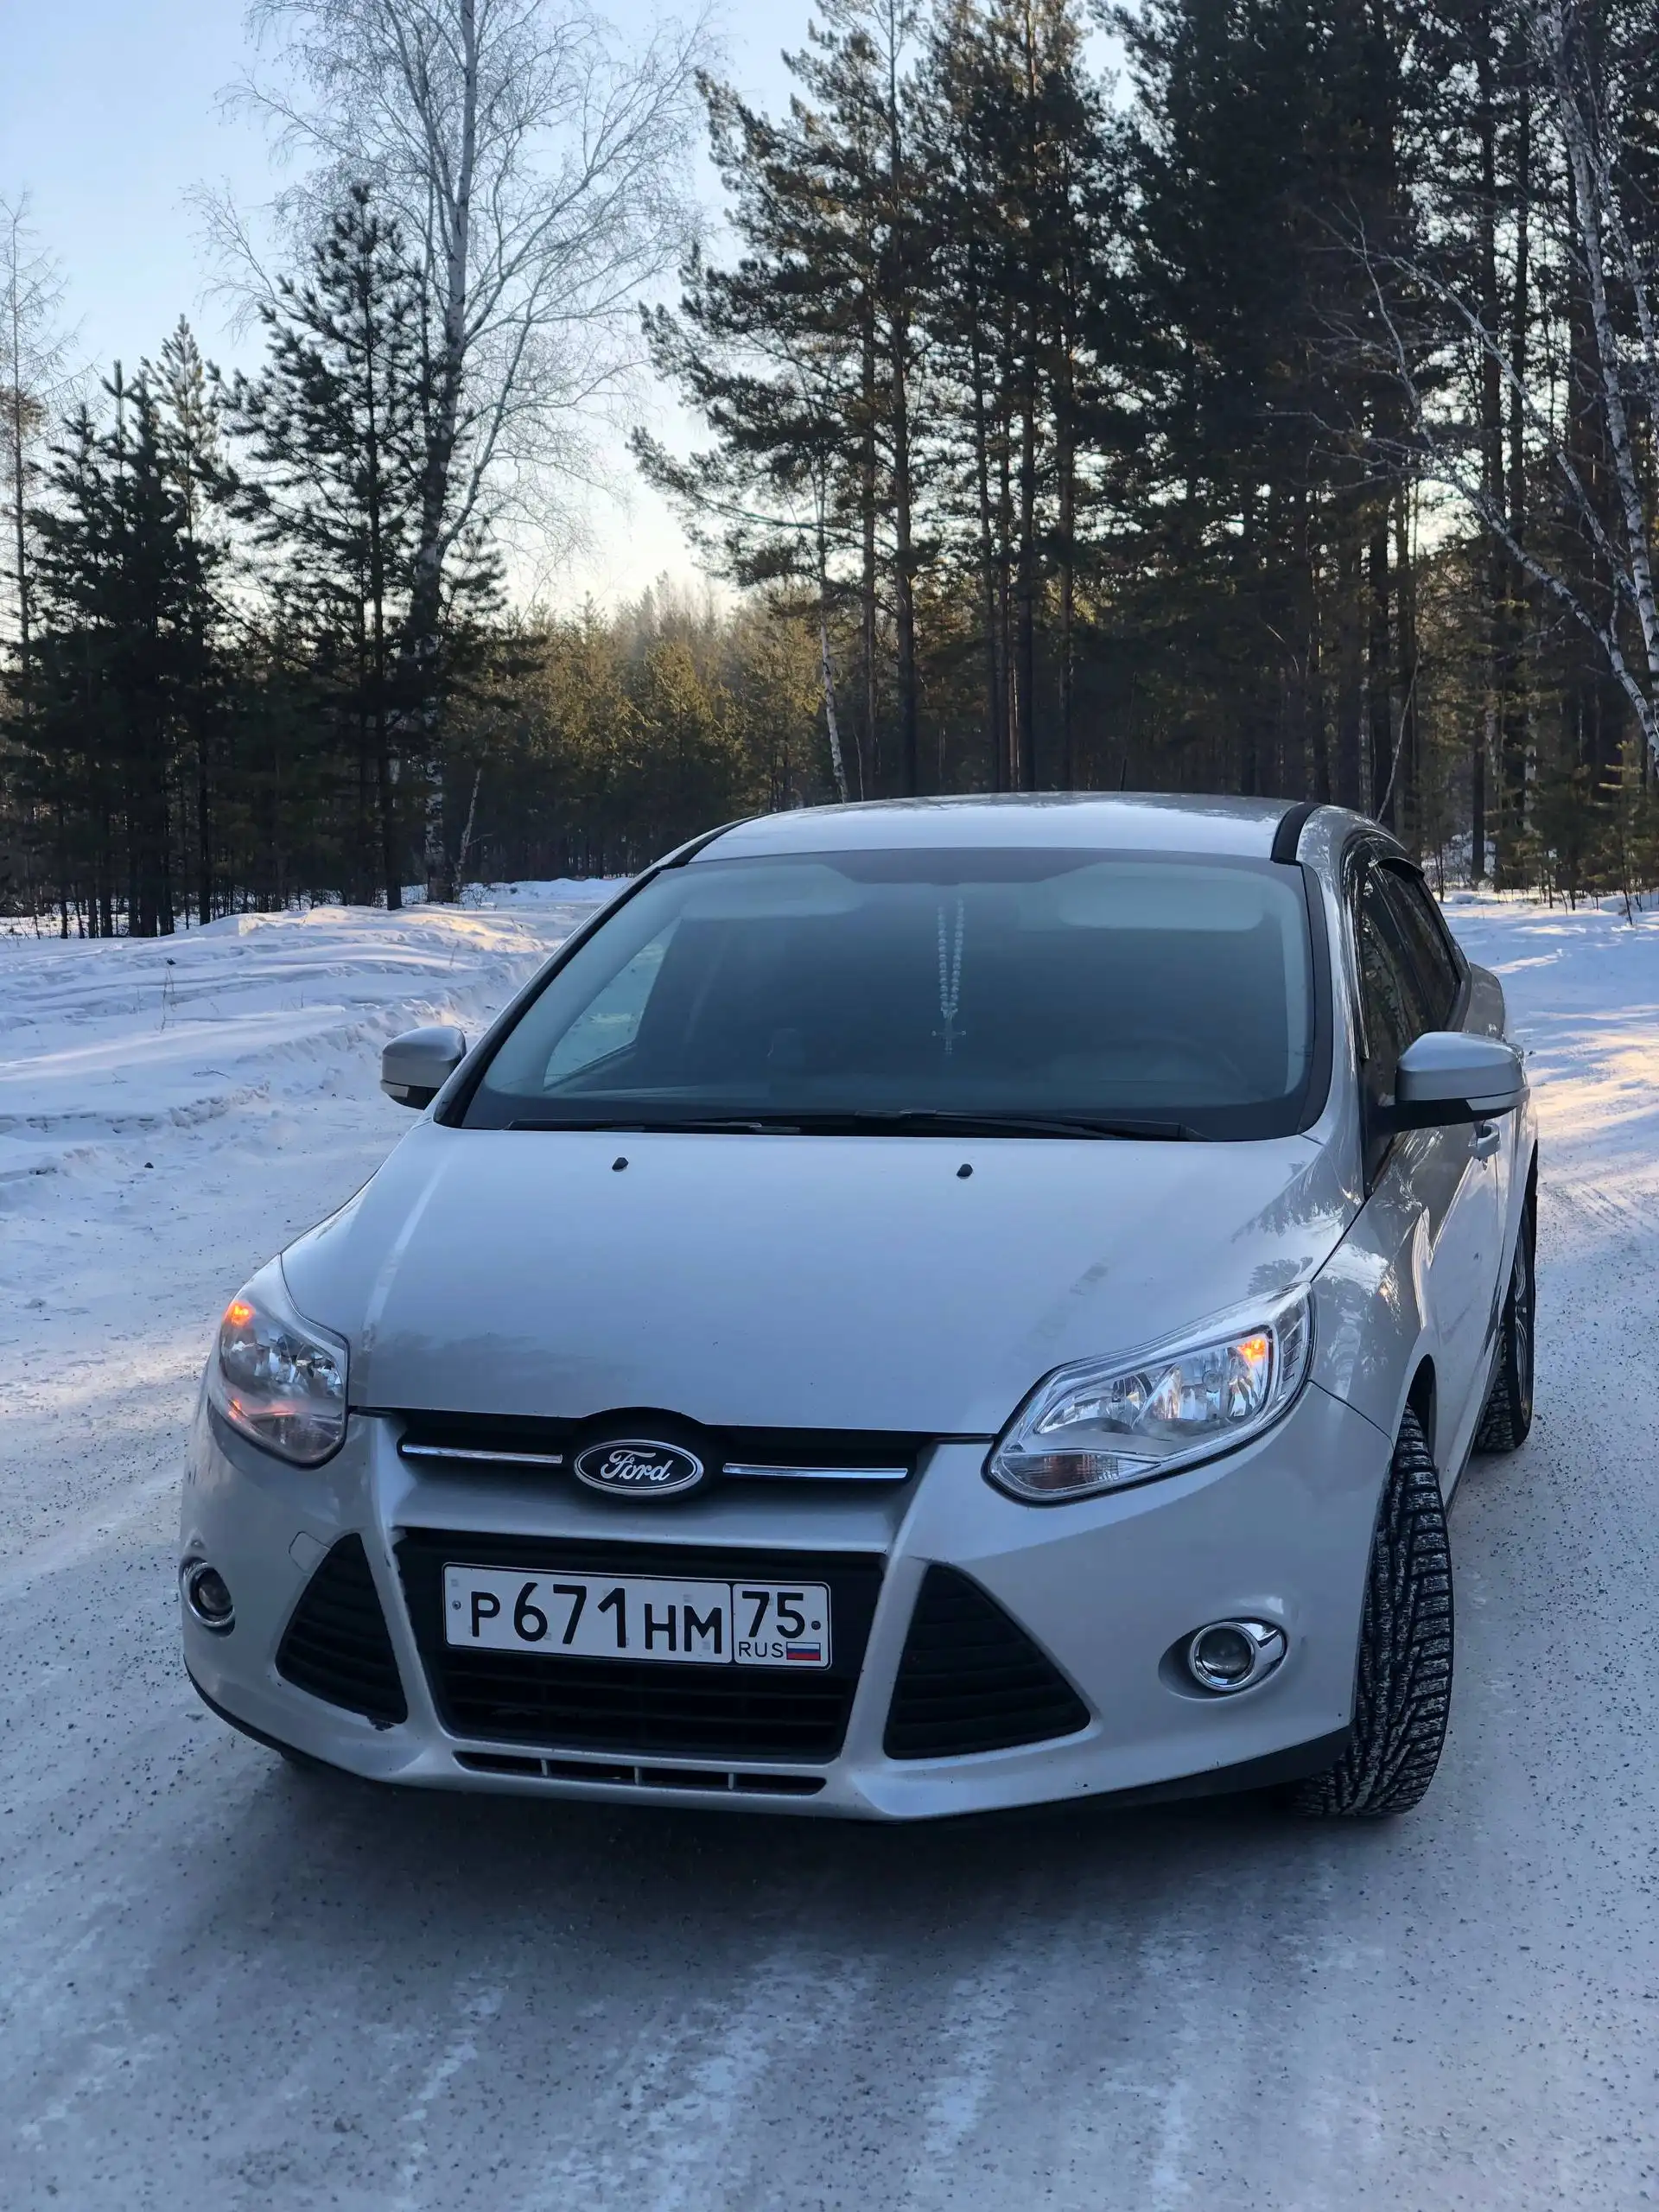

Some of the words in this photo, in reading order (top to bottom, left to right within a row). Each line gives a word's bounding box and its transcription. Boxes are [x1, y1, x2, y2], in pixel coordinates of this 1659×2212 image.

[601, 1449, 674, 1481] Ford
[741, 1591, 805, 1638] 75
[738, 1642, 784, 1658] RUS
